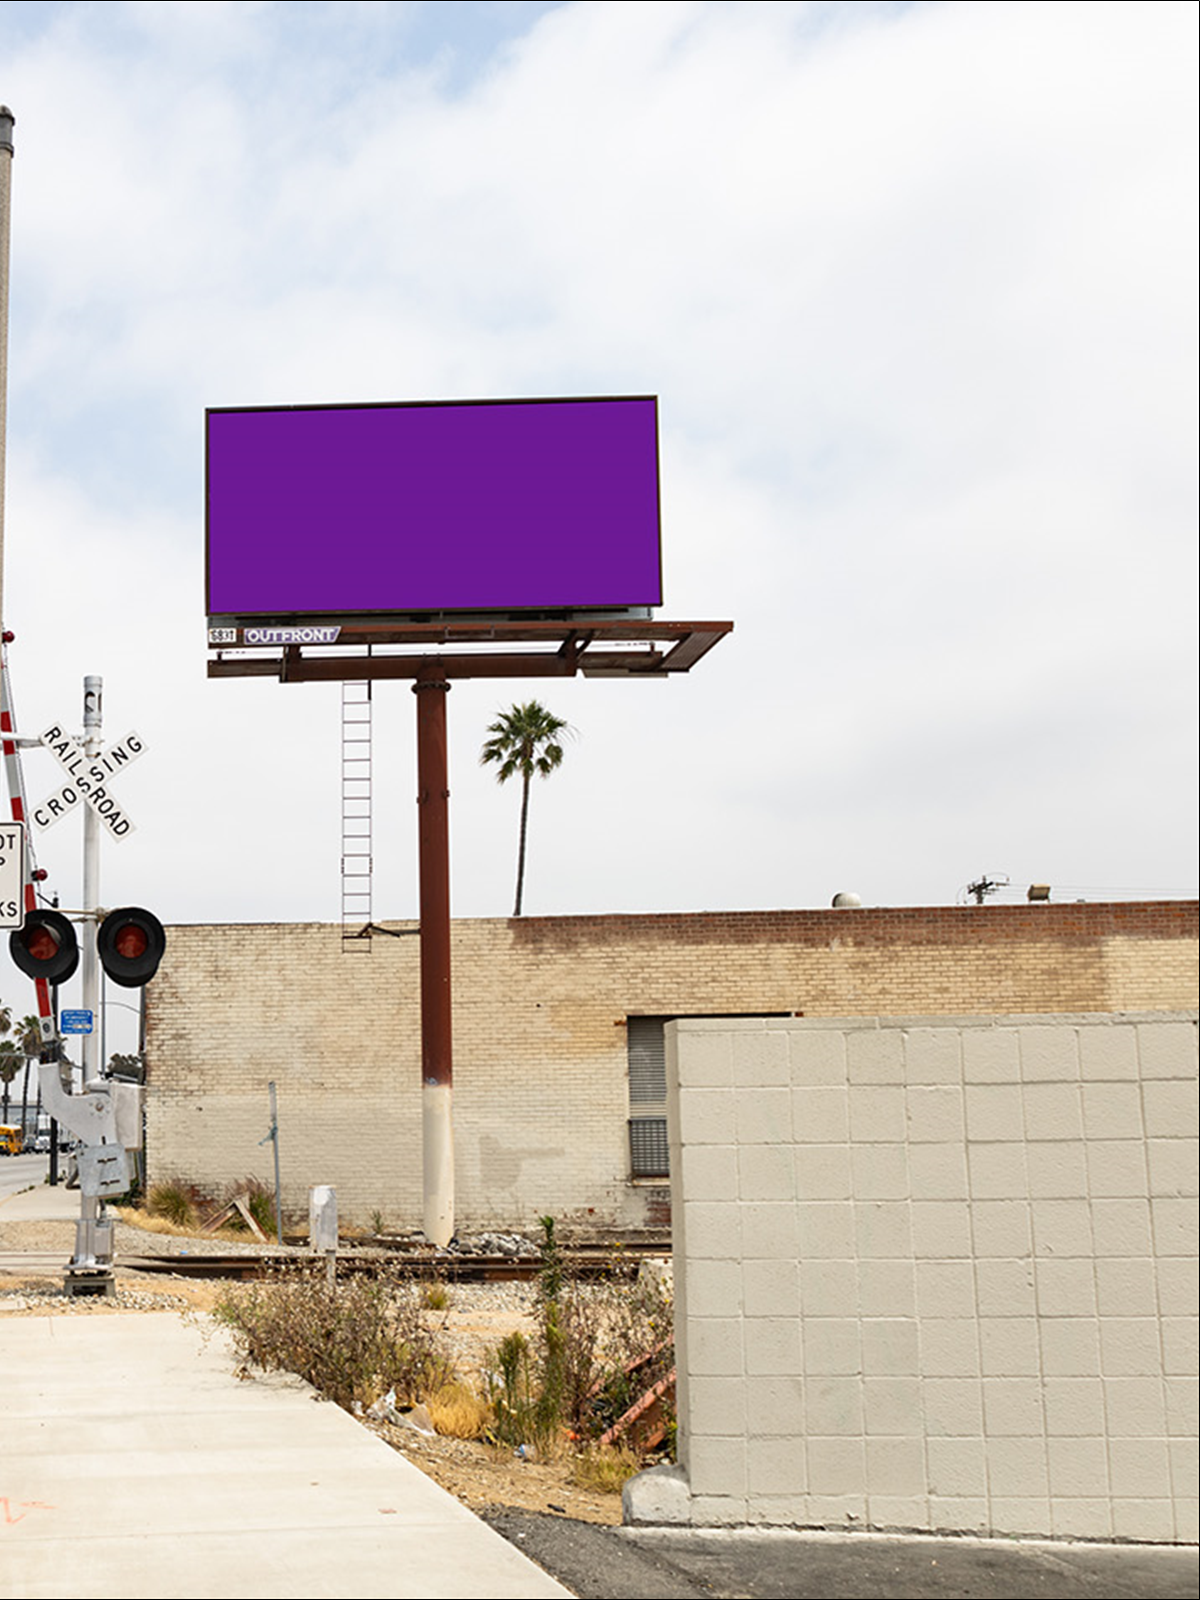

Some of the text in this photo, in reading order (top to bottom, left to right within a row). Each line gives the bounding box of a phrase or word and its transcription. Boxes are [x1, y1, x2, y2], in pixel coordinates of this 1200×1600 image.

[246, 629, 336, 643] OUTFRONT
[34, 736, 142, 826] CROSSING
[44, 726, 130, 836] RAILROAD
